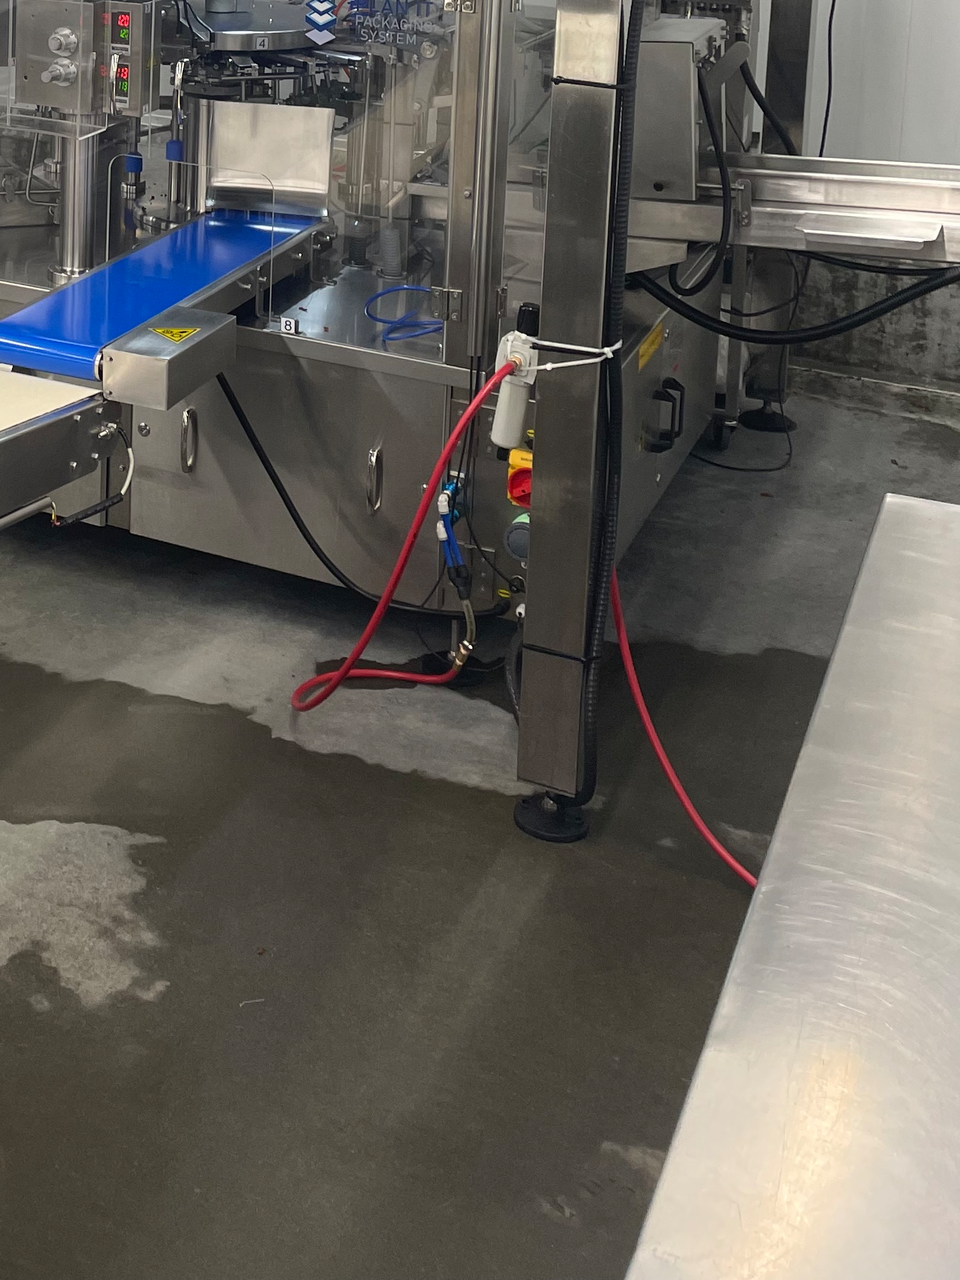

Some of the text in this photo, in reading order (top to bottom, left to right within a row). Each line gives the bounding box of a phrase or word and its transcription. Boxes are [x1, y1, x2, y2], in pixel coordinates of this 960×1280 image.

[416, 1, 434, 17] IT
[118, 14, 130, 27] 120
[355, 14, 433, 33] PACKAGING
[259, 38, 266, 49] 4
[360, 28, 417, 45] SYSTEM
[284, 319, 292, 331] 8
